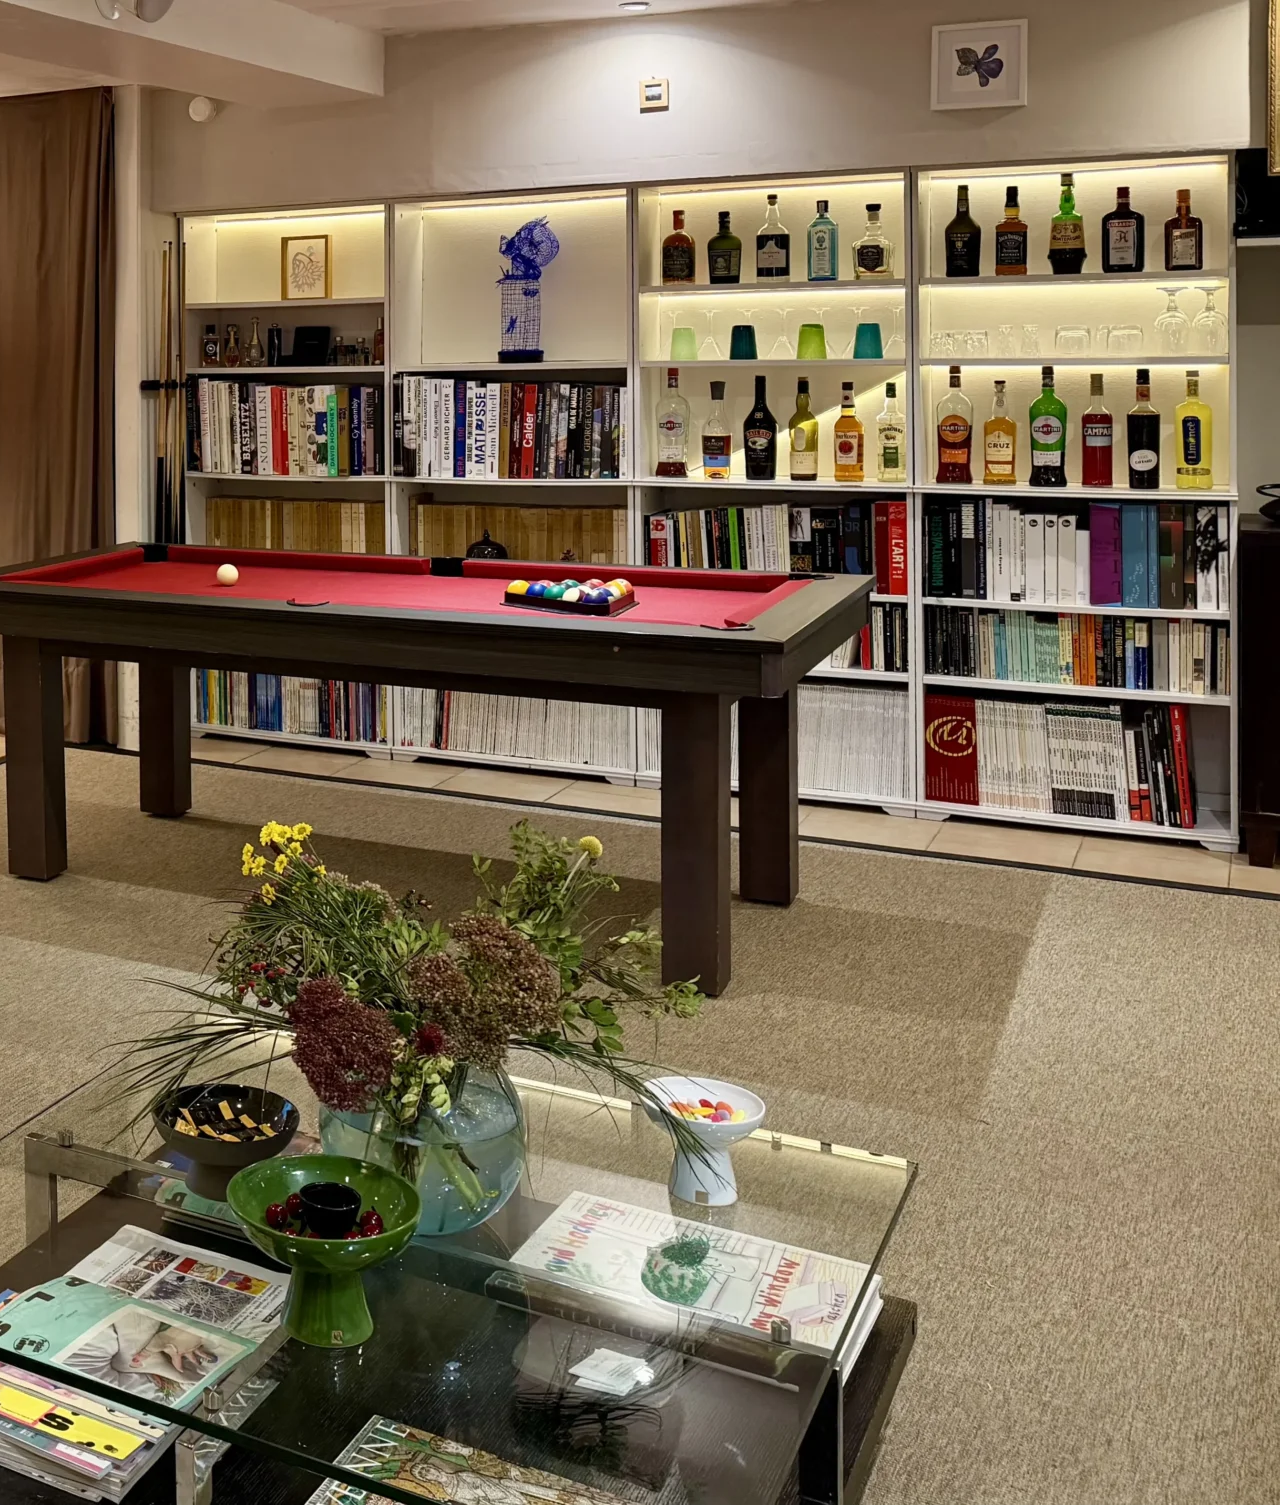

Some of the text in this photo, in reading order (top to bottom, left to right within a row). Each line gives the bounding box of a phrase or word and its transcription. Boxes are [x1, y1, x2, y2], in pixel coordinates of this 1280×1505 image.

[351, 397, 360, 439] Cy Twombly
[585, 387, 593, 416] CONDO
[241, 402, 251, 461] BASELITZ
[257, 390, 269, 464] INTUITION
[488, 394, 497, 460] Joan Mitchell
[523, 411, 534, 448] Calder
[844, 521, 860, 532] JR
[961, 503, 975, 539] BRANCUSI
[892, 539, 904, 570] L'ART
[930, 515, 944, 586] HUNDERTWASSER
[1115, 636, 1123, 658] FIELDING
[758, 1256, 801, 1311] Window
[819, 1291, 848, 1325] Taschen
